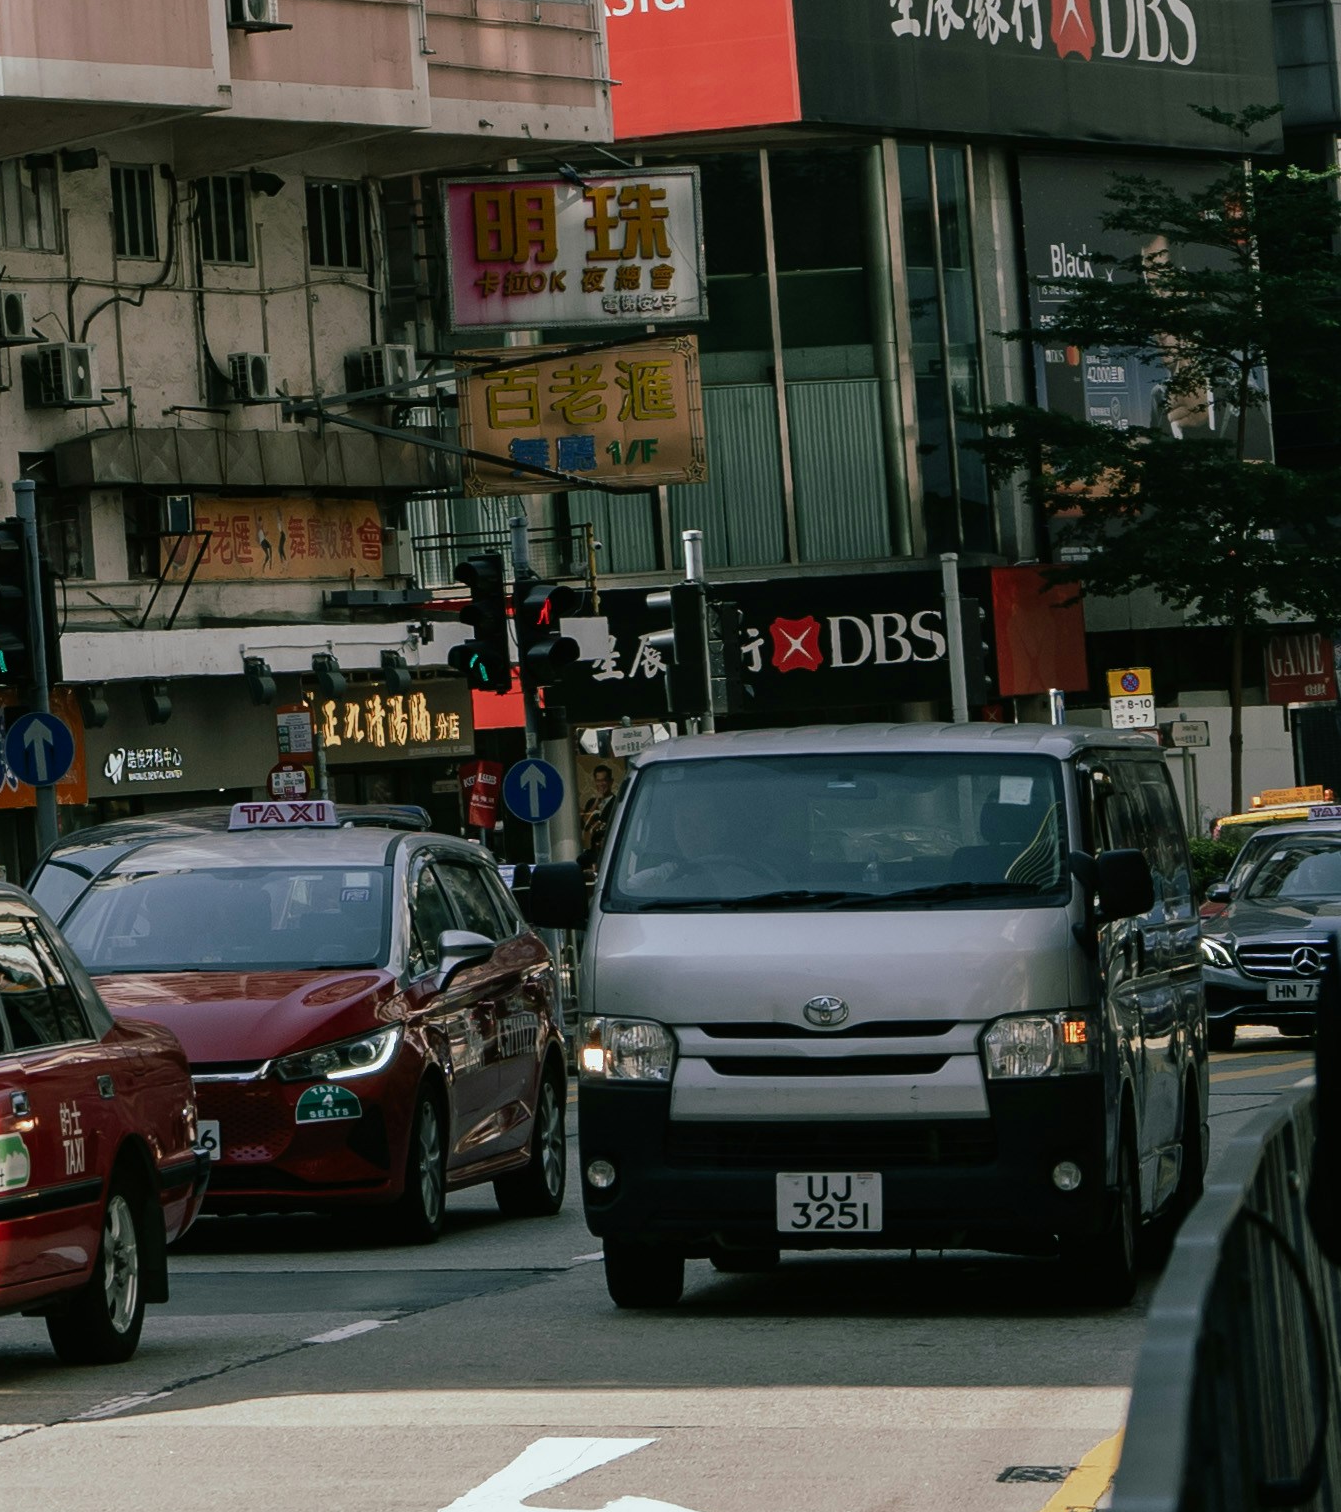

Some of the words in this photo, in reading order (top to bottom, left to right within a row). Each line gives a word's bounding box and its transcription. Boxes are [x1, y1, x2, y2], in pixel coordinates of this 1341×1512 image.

[471, 183, 672, 265] 明珠
[581, 263, 676, 294] 夜總會
[605, 437, 660, 467] 1/F
[827, 610, 947, 668] DBS
[1268, 632, 1325, 677] GAME
[1127, 698, 1152, 709] 8-10
[1128, 713, 1149, 724] 5-7
[239, 802, 326, 825] TAXI
[1275, 984, 1297, 999] HN
[311, 1085, 341, 1095] TAXI
[321, 1093, 334, 1108] 4
[59, 1100, 82, 1136] 的士
[309, 1107, 350, 1119] SEATS
[62, 1137, 85, 1176] TAXI
[807, 1175, 852, 1202] UJ
[791, 1202, 869, 1230] 3251
